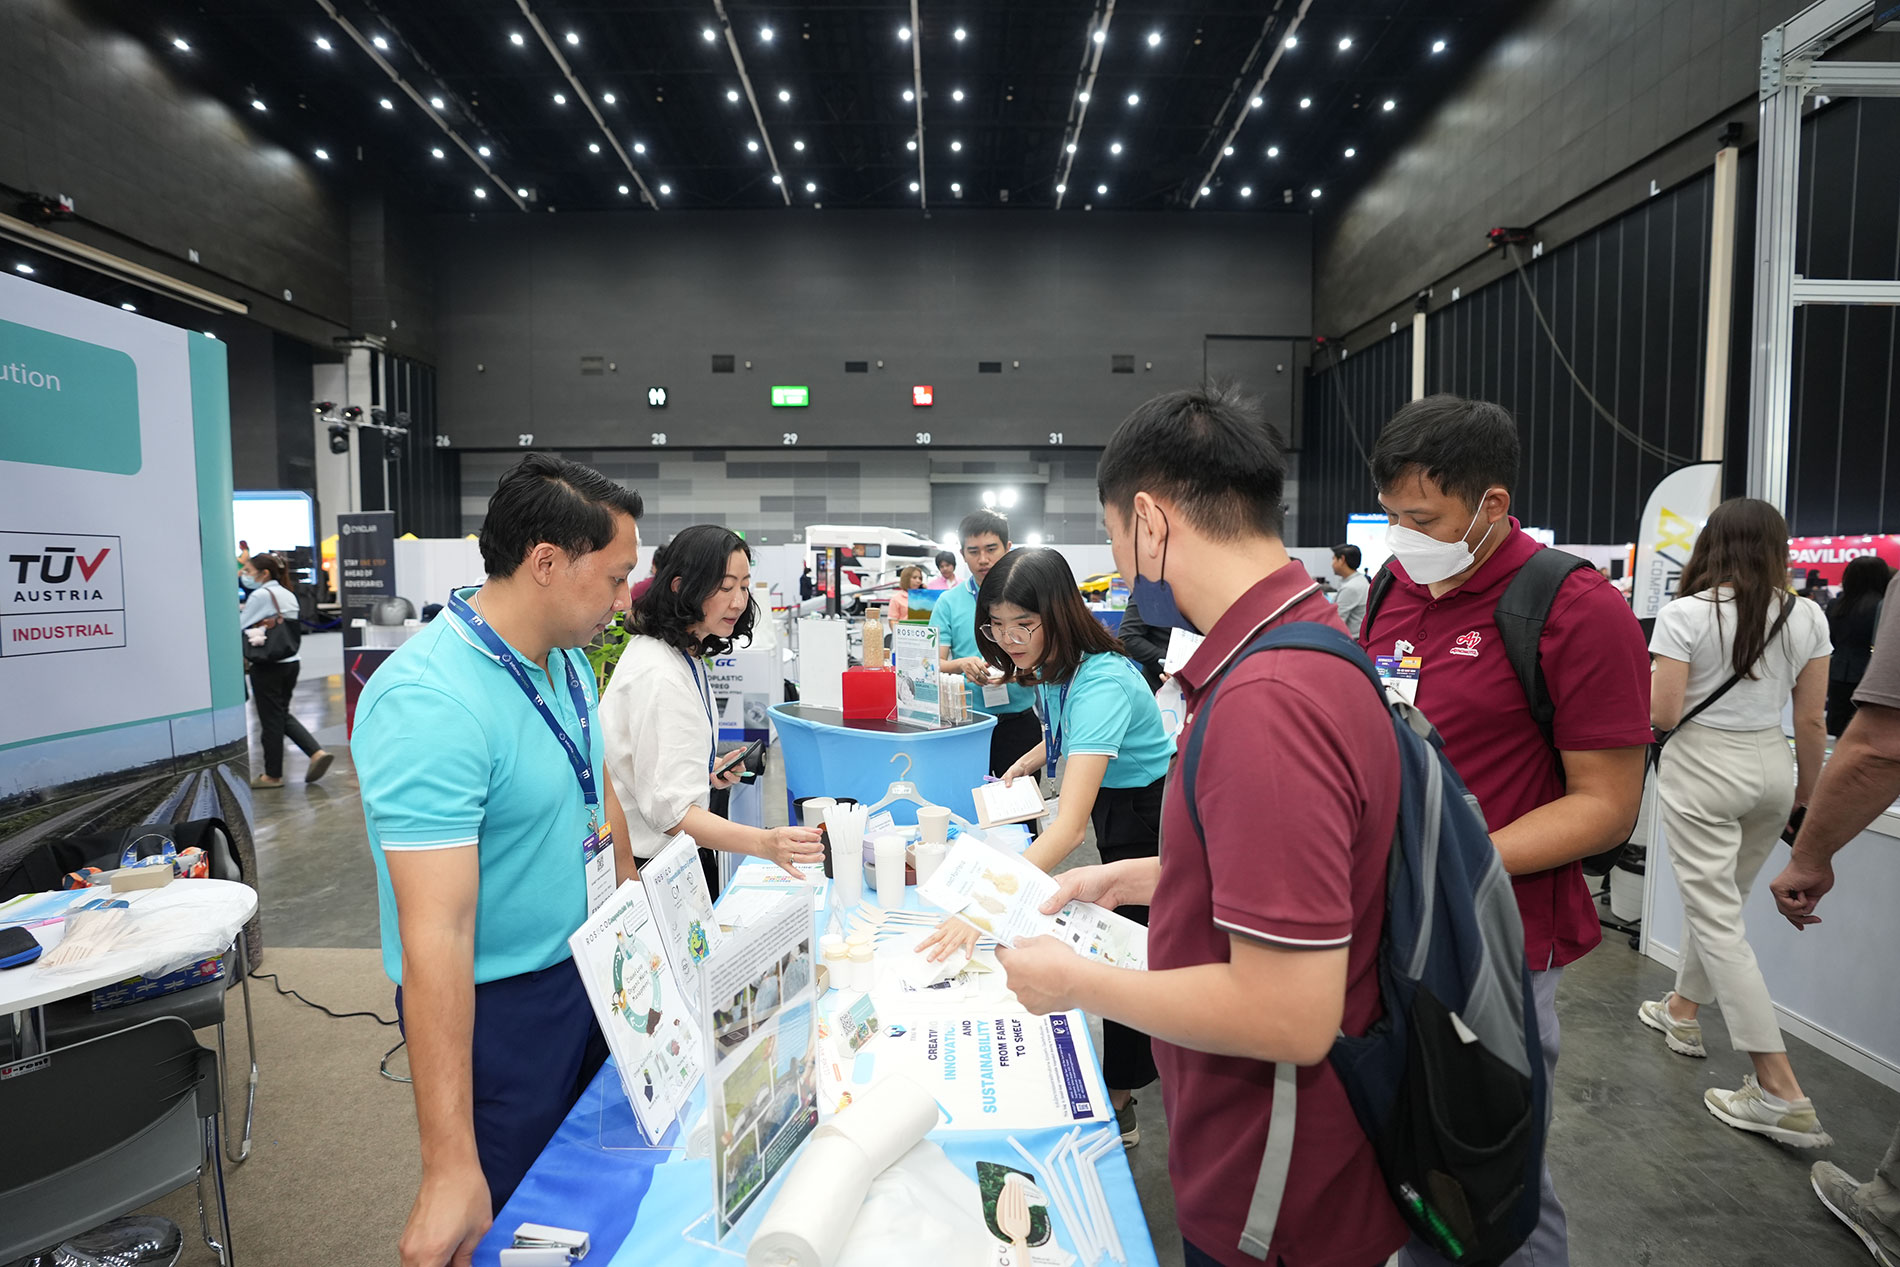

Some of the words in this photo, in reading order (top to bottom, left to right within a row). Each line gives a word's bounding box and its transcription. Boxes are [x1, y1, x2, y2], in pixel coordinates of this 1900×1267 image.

[436, 435, 450, 447] 26
[519, 434, 534, 446] 27
[652, 433, 667, 445] 28
[783, 433, 798, 445] 29
[916, 433, 931, 444] 30
[1049, 433, 1063, 444] 31
[14, 590, 103, 602] AUSTRIA
[13, 624, 114, 642] INDUSTRIAL
[715, 658, 737, 667] GC
[962, 1020, 972, 1036] AND
[995, 1018, 1006, 1041] FARM
[1011, 1019, 1024, 1043] SHELF
[998, 1043, 1010, 1067] FROM
[1015, 1045, 1026, 1057] TO
[977, 1020, 998, 1113] SUSTAINABILITY
